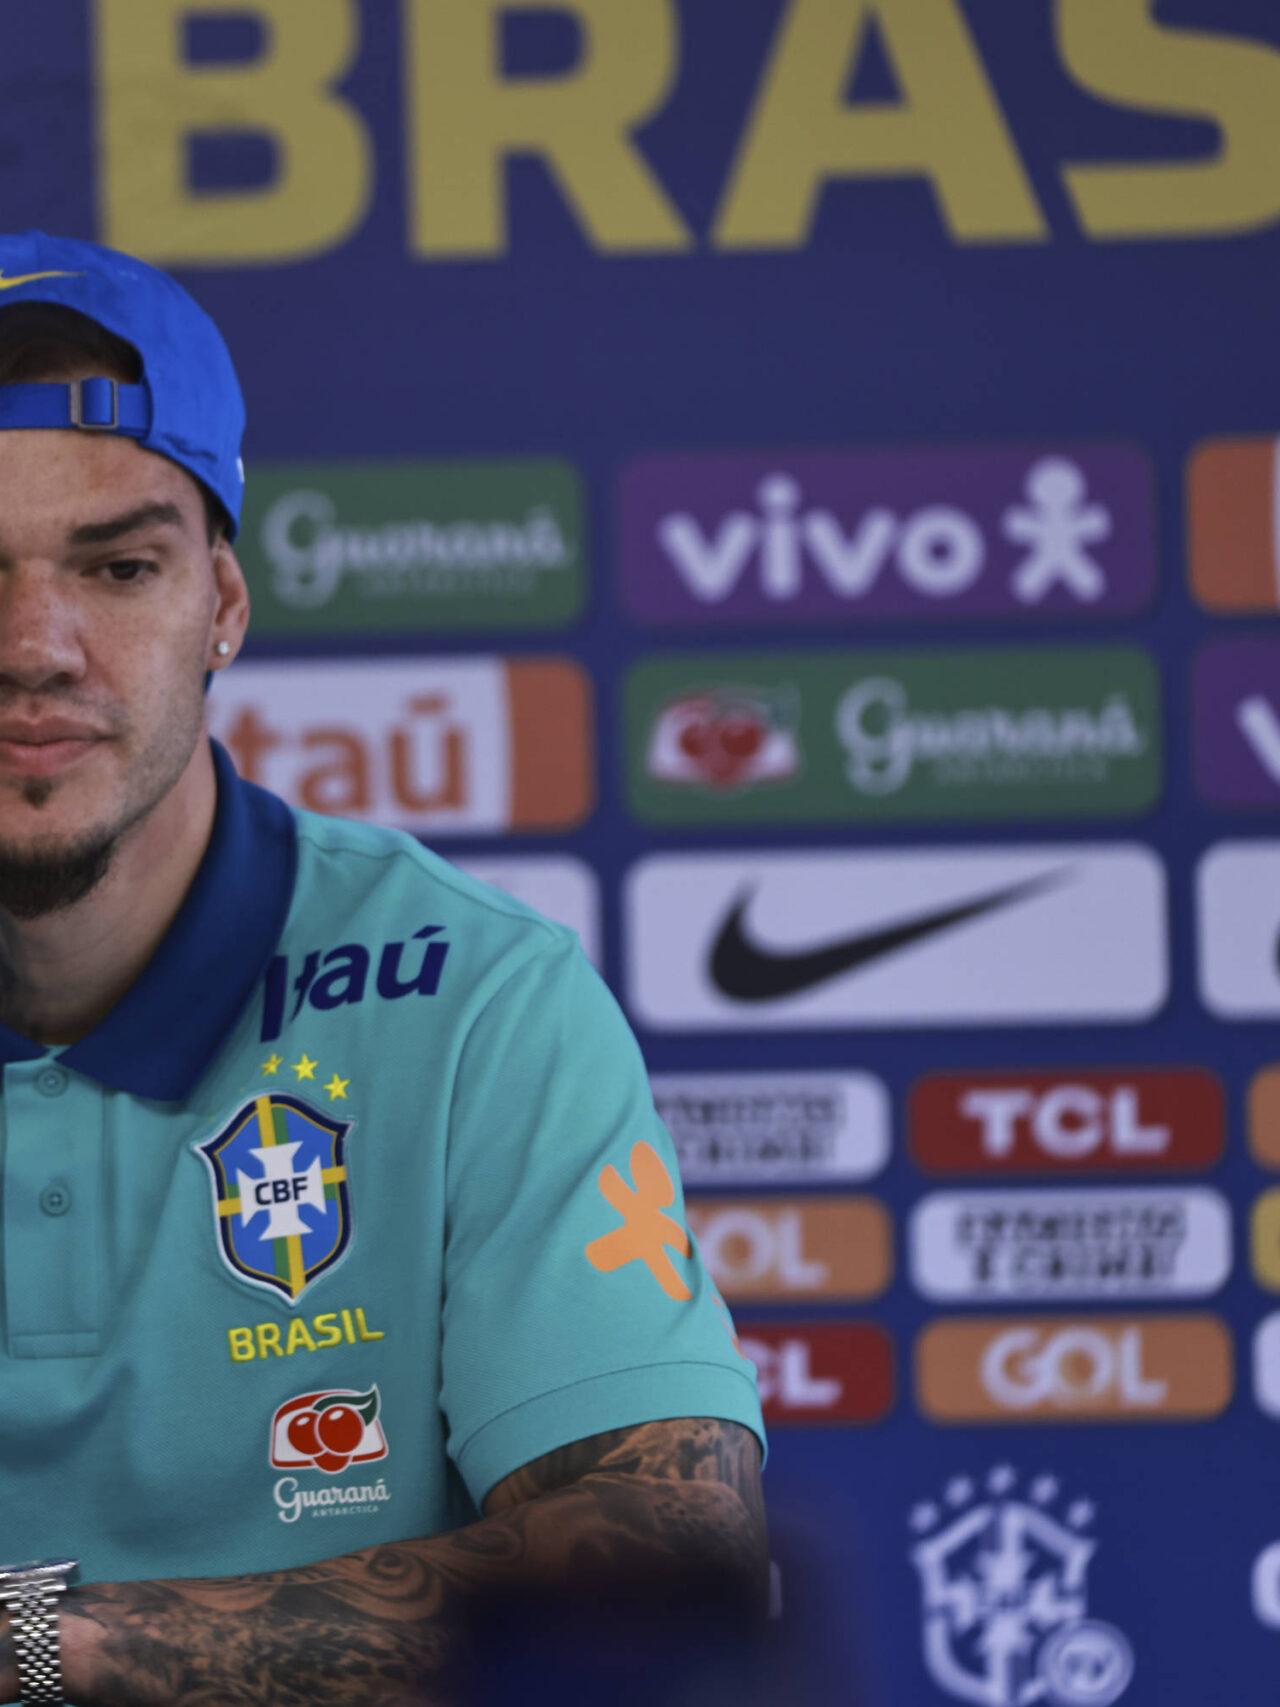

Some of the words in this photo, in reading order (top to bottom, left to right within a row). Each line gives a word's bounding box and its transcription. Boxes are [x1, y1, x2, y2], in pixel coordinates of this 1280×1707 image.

[660, 472, 986, 602] vivo
[226, 698, 468, 816] taú
[960, 1084, 1172, 1157] TCL
[254, 1176, 309, 1206] CBF
[686, 1208, 830, 1290] OL
[228, 1307, 385, 1363] BRASIL
[979, 1325, 1168, 1411] GOL
[273, 1476, 391, 1523] Guaraná
[312, 1505, 379, 1518] ANTARCTICA
